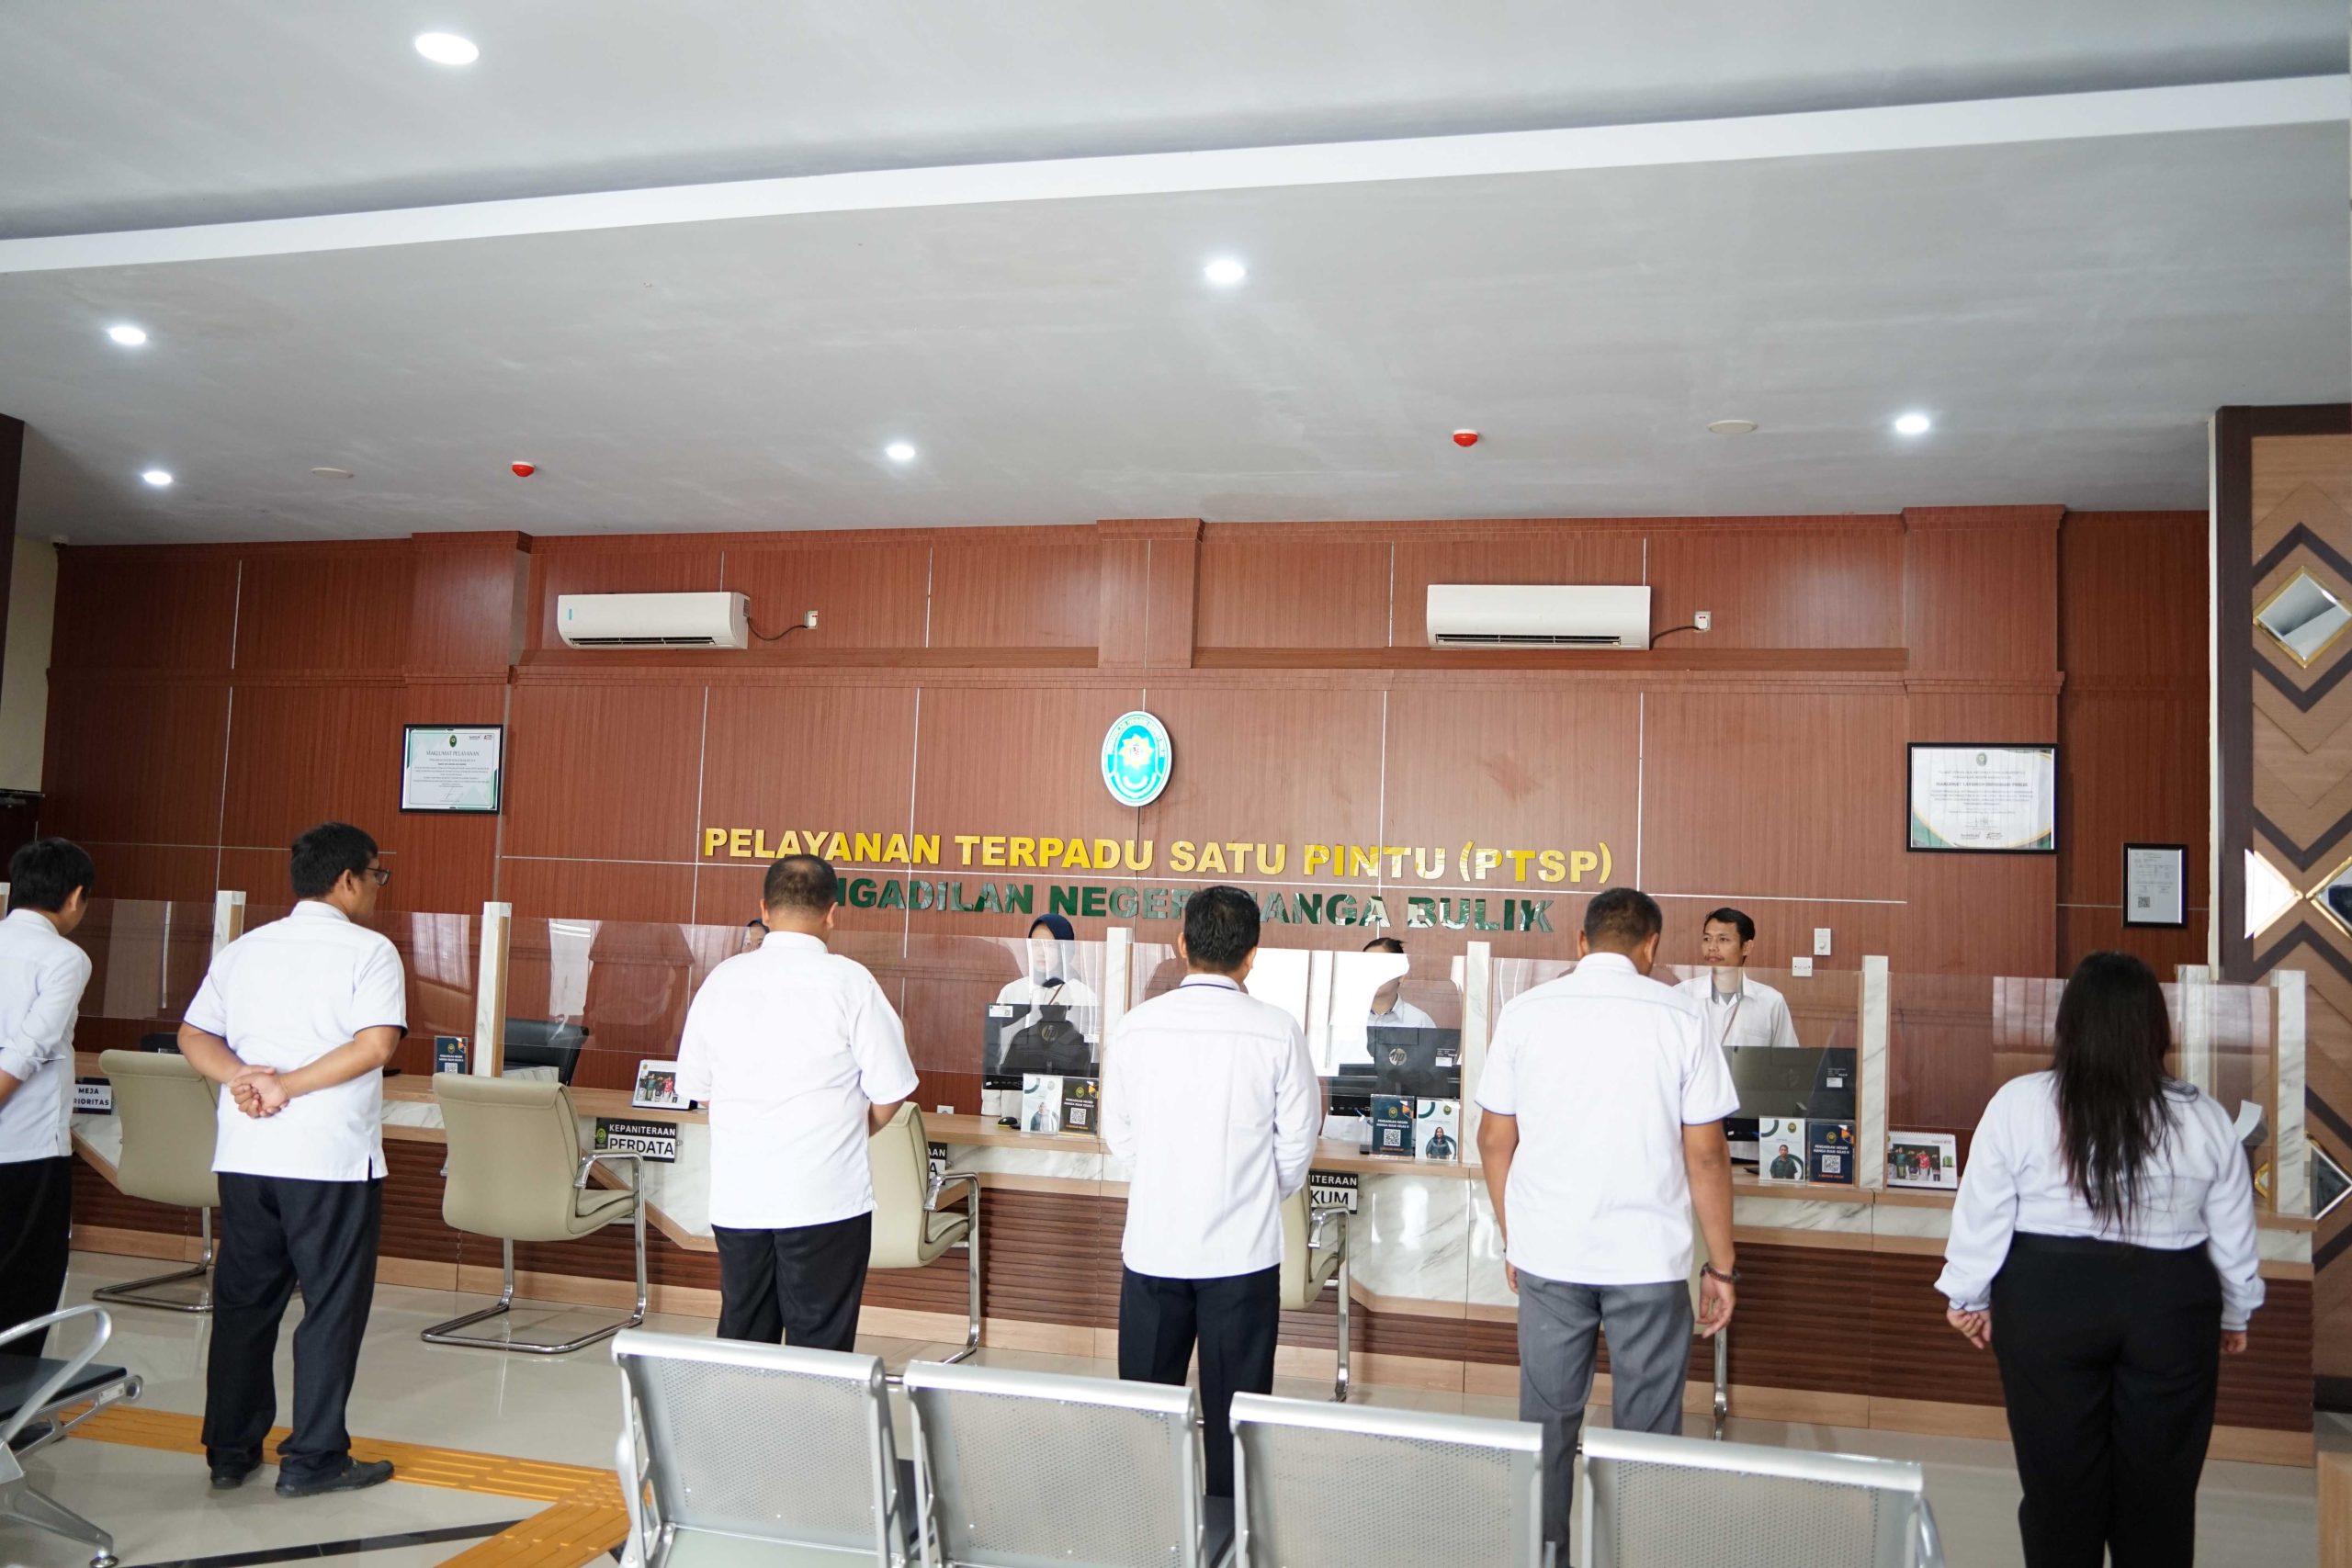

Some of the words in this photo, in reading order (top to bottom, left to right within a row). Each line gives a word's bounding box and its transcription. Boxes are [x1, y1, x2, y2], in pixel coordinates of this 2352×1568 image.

[704, 828, 940, 864] PELAYANAN
[955, 835, 1153, 870] TERPADU
[1169, 840, 1286, 874] SATU
[1303, 843, 1447, 880] PINTU
[1459, 840, 1613, 885] (PTSP)
[837, 877, 1033, 915] GADILAN
[1049, 886, 1193, 919] NEGER
[1252, 892, 1392, 928] ANGA
[1408, 897, 1555, 933] BULIK
[74, 1098, 109, 1106] RIORITAS
[609, 1124, 676, 1136] KEPANITERAAN
[1308, 1175, 1357, 1186] ITERAAN
[1310, 1190, 1349, 1204] KUM
